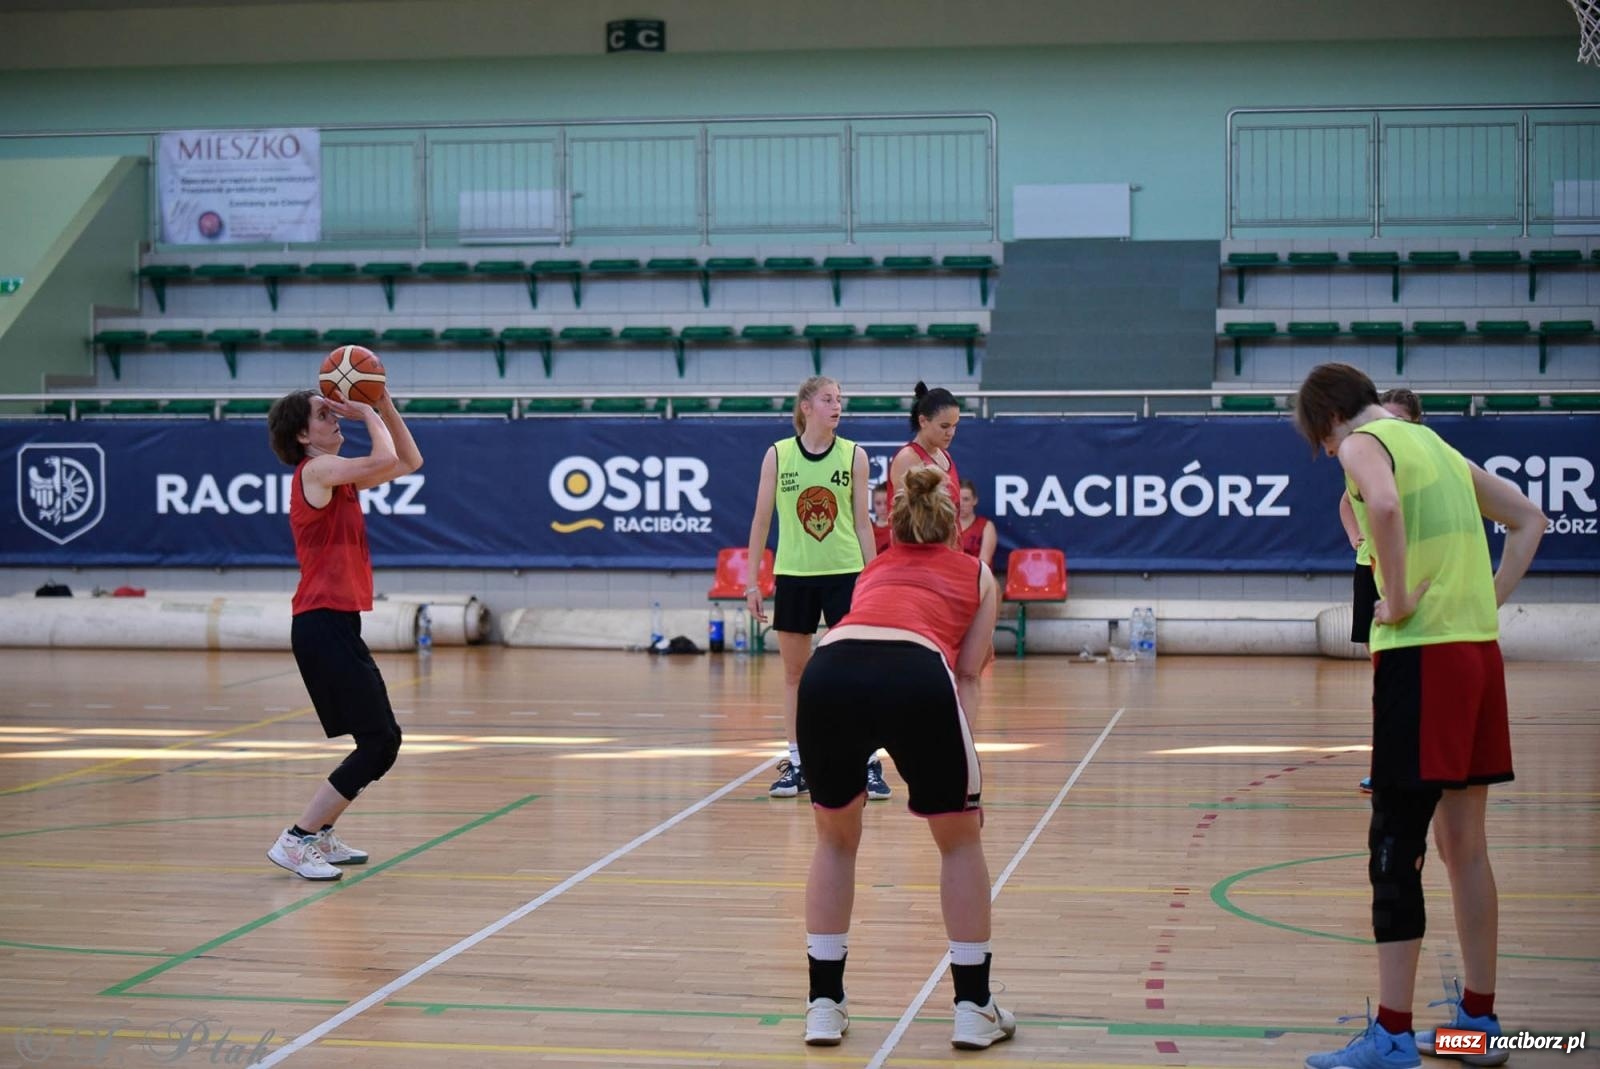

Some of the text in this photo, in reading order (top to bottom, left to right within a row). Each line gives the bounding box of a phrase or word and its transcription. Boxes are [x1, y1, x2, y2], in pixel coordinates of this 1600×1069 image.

[637, 29, 660, 48] C
[178, 134, 301, 161] MIESZKO
[830, 469, 850, 487] 45
[995, 460, 1291, 517] RACIBÓRZ
[1483, 455, 1598, 513] SiR
[156, 474, 426, 515] RACIRZ
[613, 512, 713, 532] RACIBÓRZ
[1494, 514, 1598, 534] RBÓRZ
